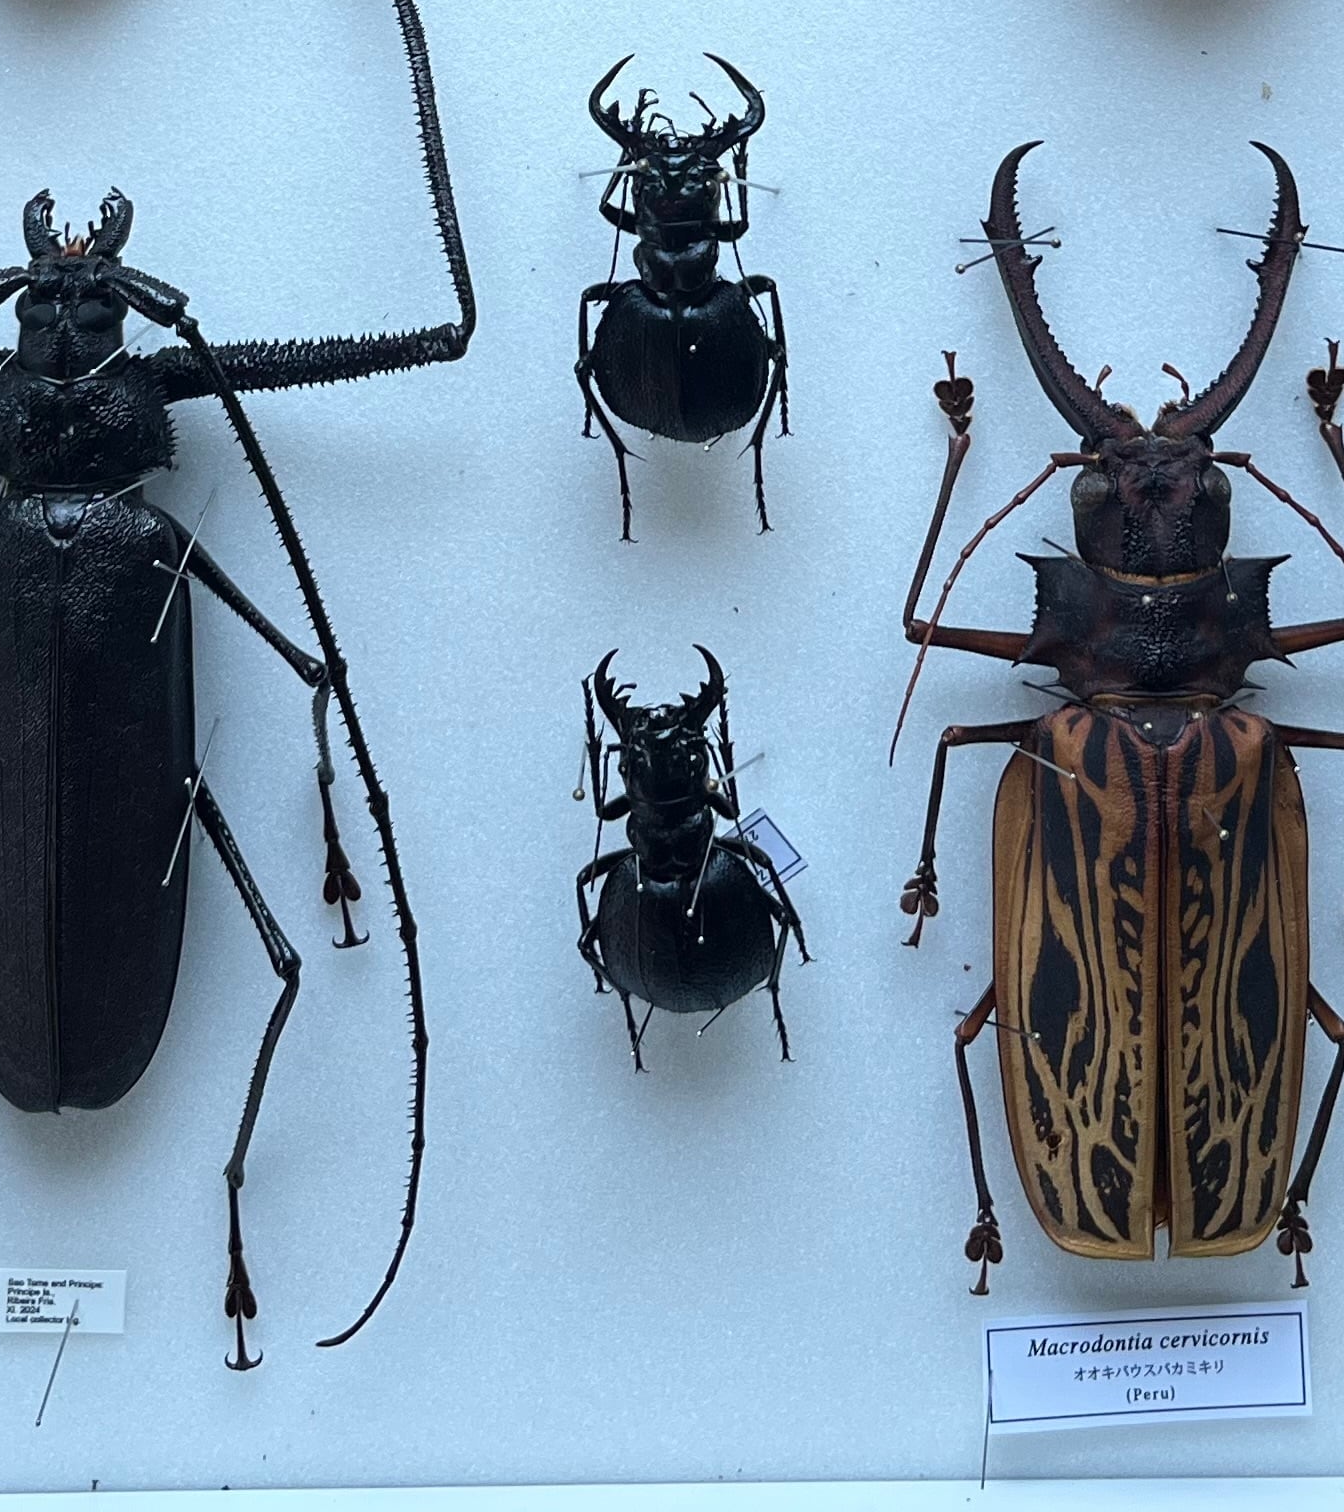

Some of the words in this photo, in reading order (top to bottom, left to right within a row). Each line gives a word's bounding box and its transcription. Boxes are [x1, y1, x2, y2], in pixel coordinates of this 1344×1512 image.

[27, 1278, 49, 1287] Tome
[51, 1279, 67, 1288] and
[7, 1287, 41, 1297] Principe
[6, 1315, 29, 1324] Local
[30, 1316, 65, 1324] collector
[1027, 1332, 1153, 1357] Macrodontia
[1159, 1327, 1270, 1350] cervicornis
[1073, 1359, 1225, 1381] オオキバウスバカミキリ
[1126, 1385, 1176, 1405] (Peru)
